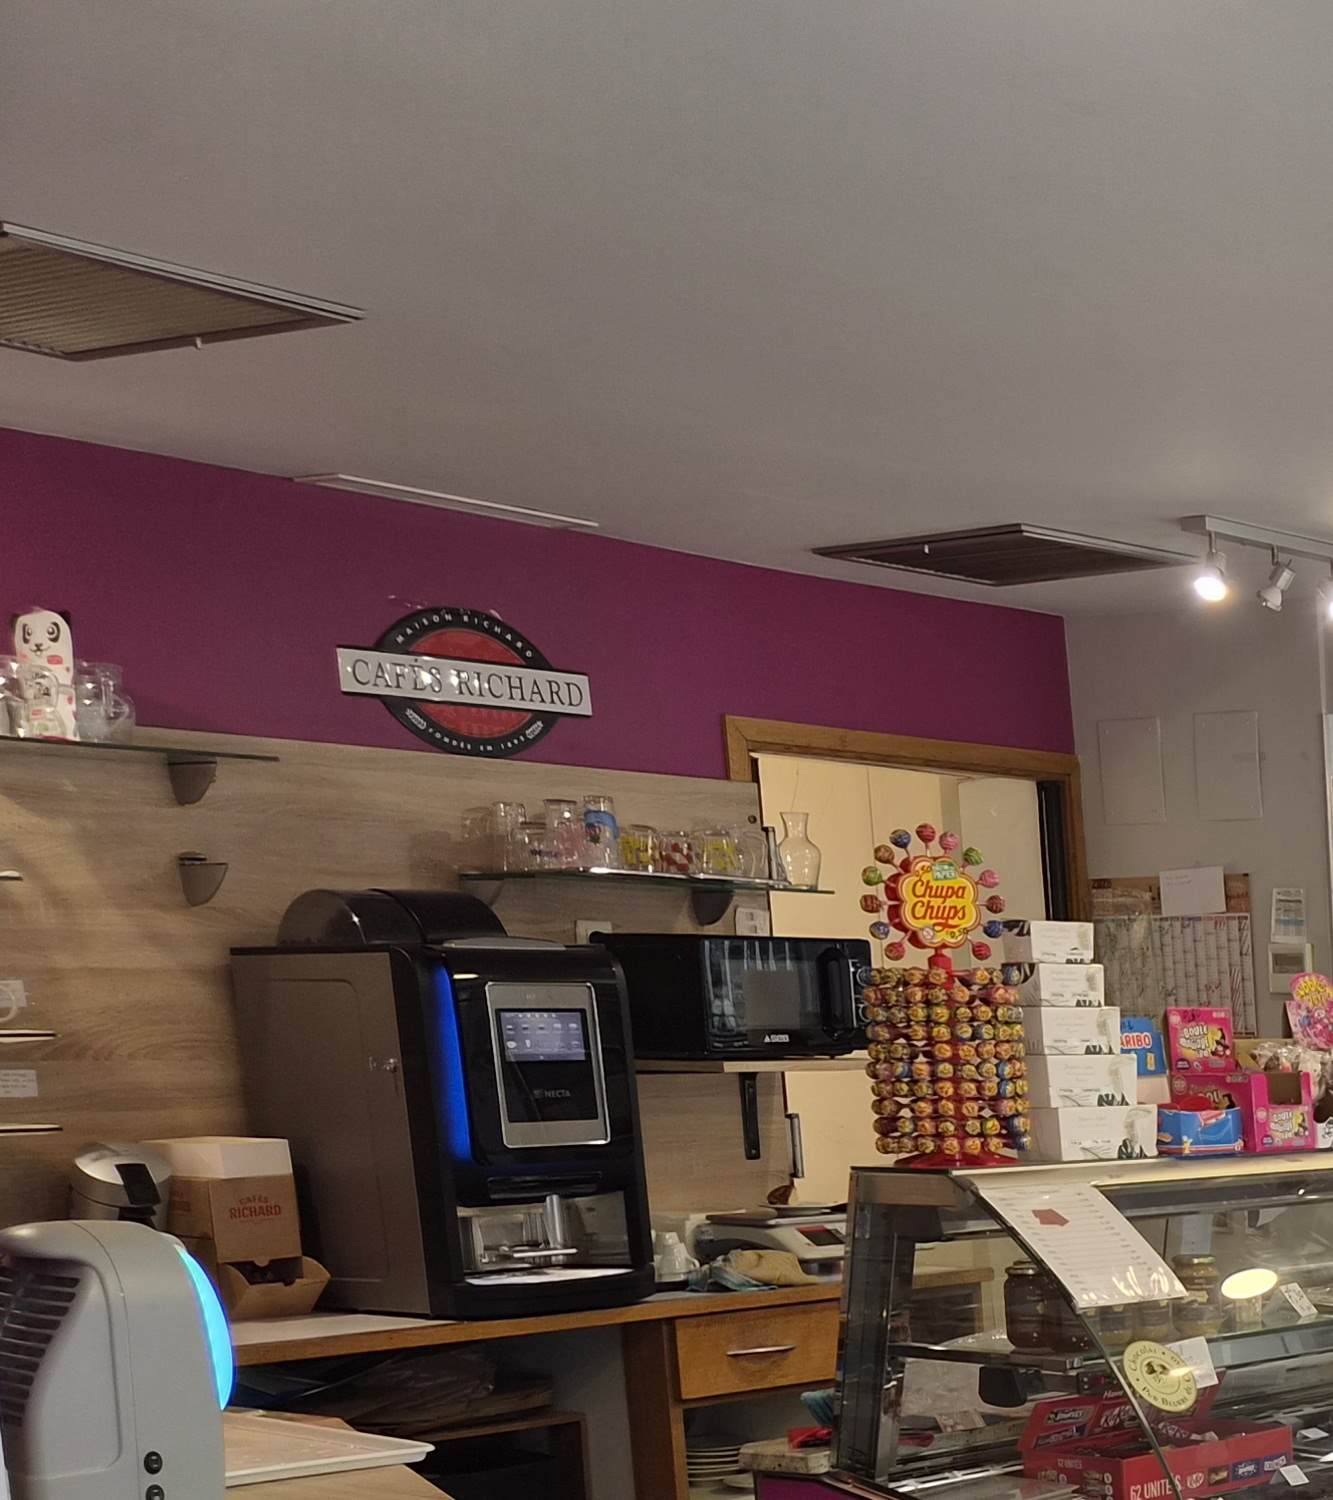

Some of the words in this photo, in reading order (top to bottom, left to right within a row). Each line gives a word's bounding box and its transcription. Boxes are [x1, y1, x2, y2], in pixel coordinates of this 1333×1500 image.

[396, 613, 452, 644] MAISON
[463, 615, 533, 658] RICHARD
[351, 658, 443, 694] CAFÉS
[456, 668, 584, 708] RICHARD
[911, 879, 967, 904] Chupa
[911, 900, 966, 928] Chups
[1120, 1034, 1151, 1047] ARIBO
[545, 1089, 571, 1098] NECTA
[229, 1204, 282, 1219] RICHARD
